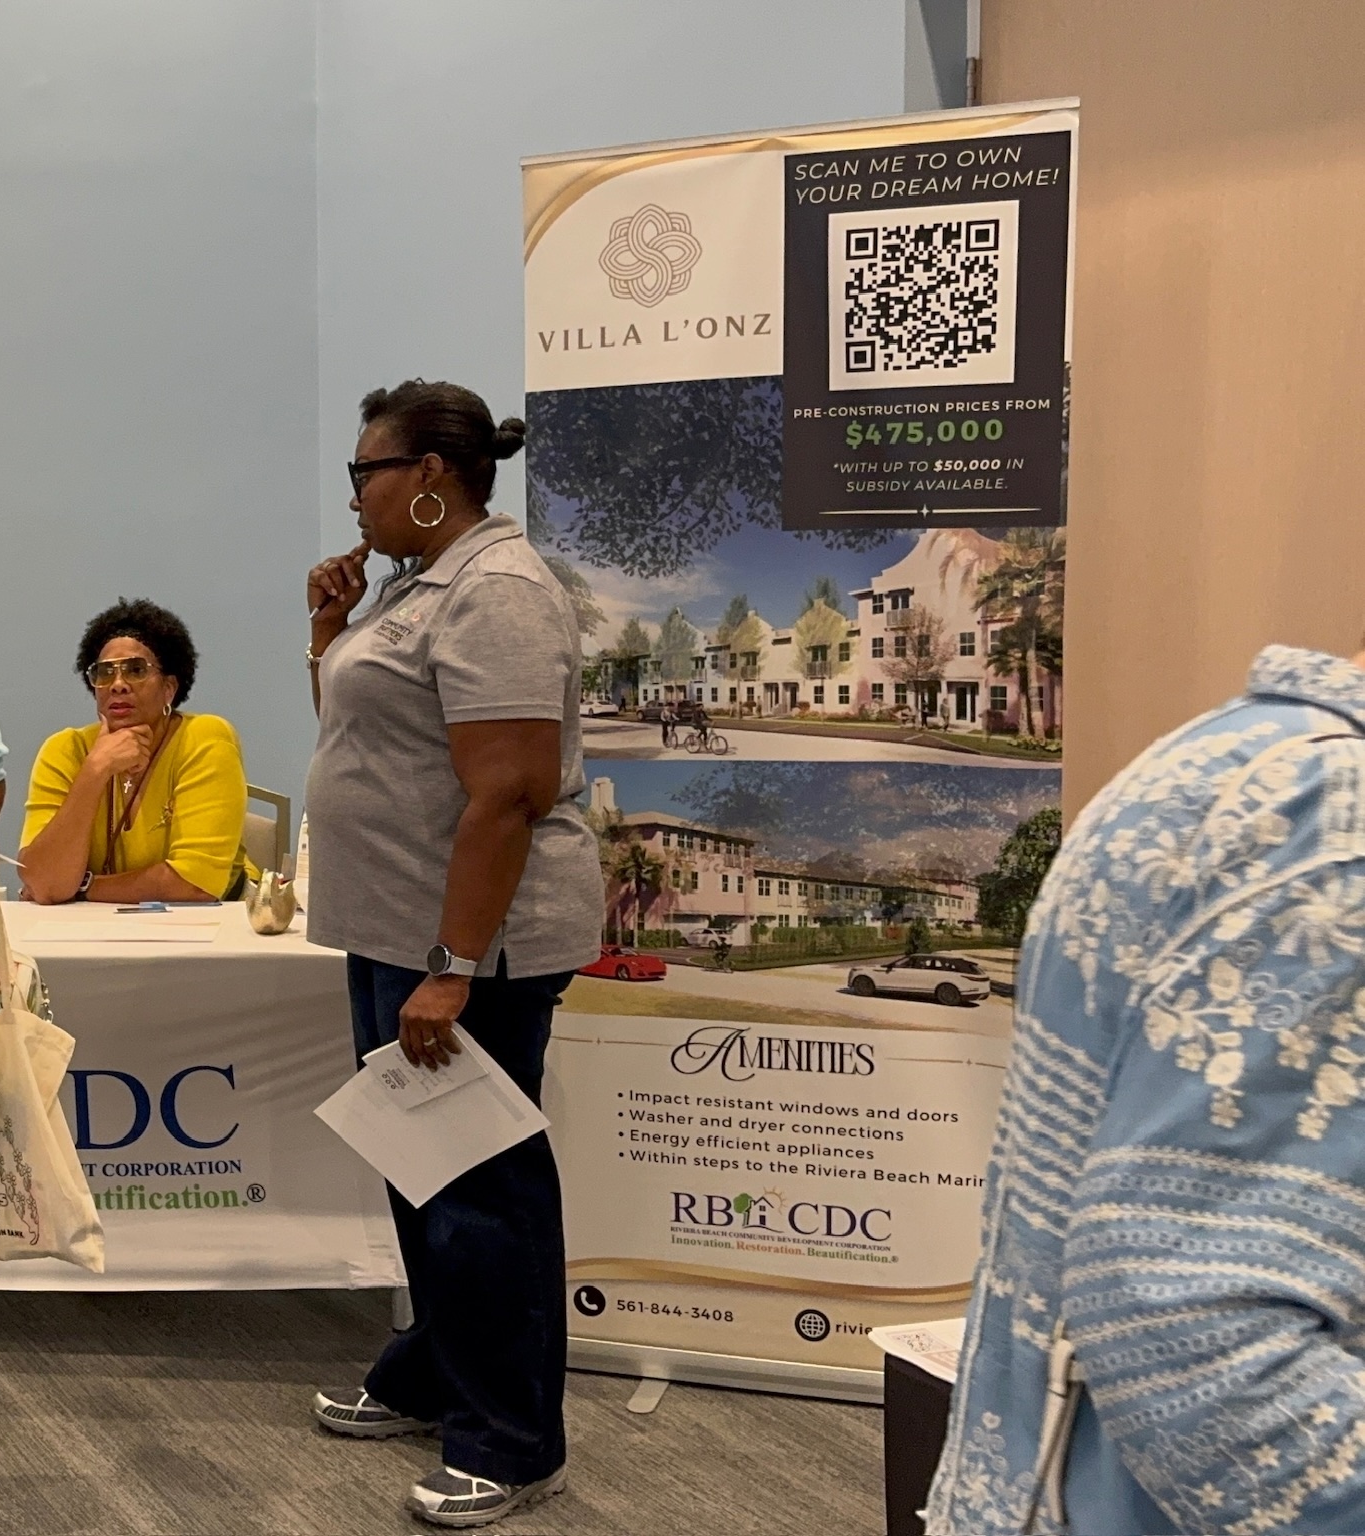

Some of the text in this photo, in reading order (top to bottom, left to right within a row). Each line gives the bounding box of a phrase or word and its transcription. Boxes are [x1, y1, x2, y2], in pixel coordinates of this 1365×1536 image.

[794, 146, 1022, 181] SCAN ME TO OWN
[795, 168, 1059, 205] YOUR DREAM HOME!
[538, 313, 772, 353] VILLA L'ONZ
[793, 398, 1051, 419] PRE-CONSTRUCTION PRICES FROM
[845, 418, 1004, 450] $475,000
[882, 462, 904, 473] UP
[908, 460, 929, 473] TO
[932, 458, 1002, 473] $50,000
[1006, 458, 1024, 470] IN
[845, 477, 1008, 493] SUBSIDY AVAILABLE.
[671, 1026, 875, 1082] AMENITIES
[66, 1064, 240, 1150] DC
[629, 1089, 959, 1123] Impact resistant windows and doors
[629, 1109, 905, 1142] Washer and dryer connections
[630, 1129, 875, 1160] Energy efficient appliances
[102, 1159, 243, 1177] CORPORATION
[629, 1149, 986, 1188] Within steps to the Riviera Beach Mari
[671, 1234, 734, 1249] Innovation.
[736, 1241, 805, 1256] Restoration.
[702, 1228, 727, 1237] BEACH
[835, 1241, 891, 1252] CORPORATION
[616, 1299, 734, 1322] 561-844-3408
